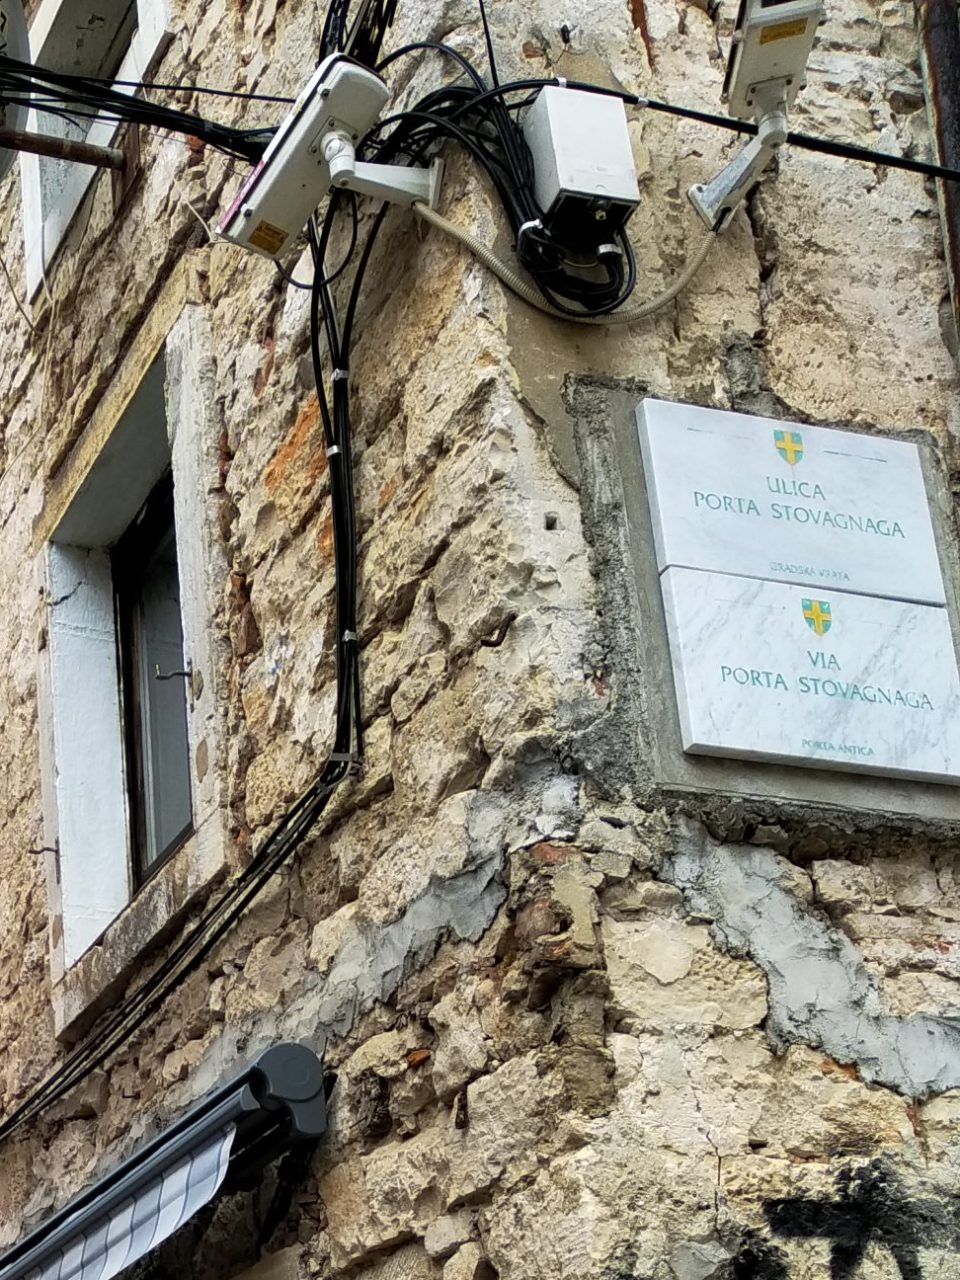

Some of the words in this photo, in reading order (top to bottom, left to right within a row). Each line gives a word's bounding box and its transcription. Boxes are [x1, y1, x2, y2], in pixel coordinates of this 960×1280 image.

[765, 476, 827, 500] ULICA
[693, 491, 761, 517] PORTA
[771, 503, 906, 539] STOVAGNAGA
[807, 650, 841, 671] VIA
[721, 665, 789, 691] PORTA
[799, 676, 934, 711] STOVAGNAGA
